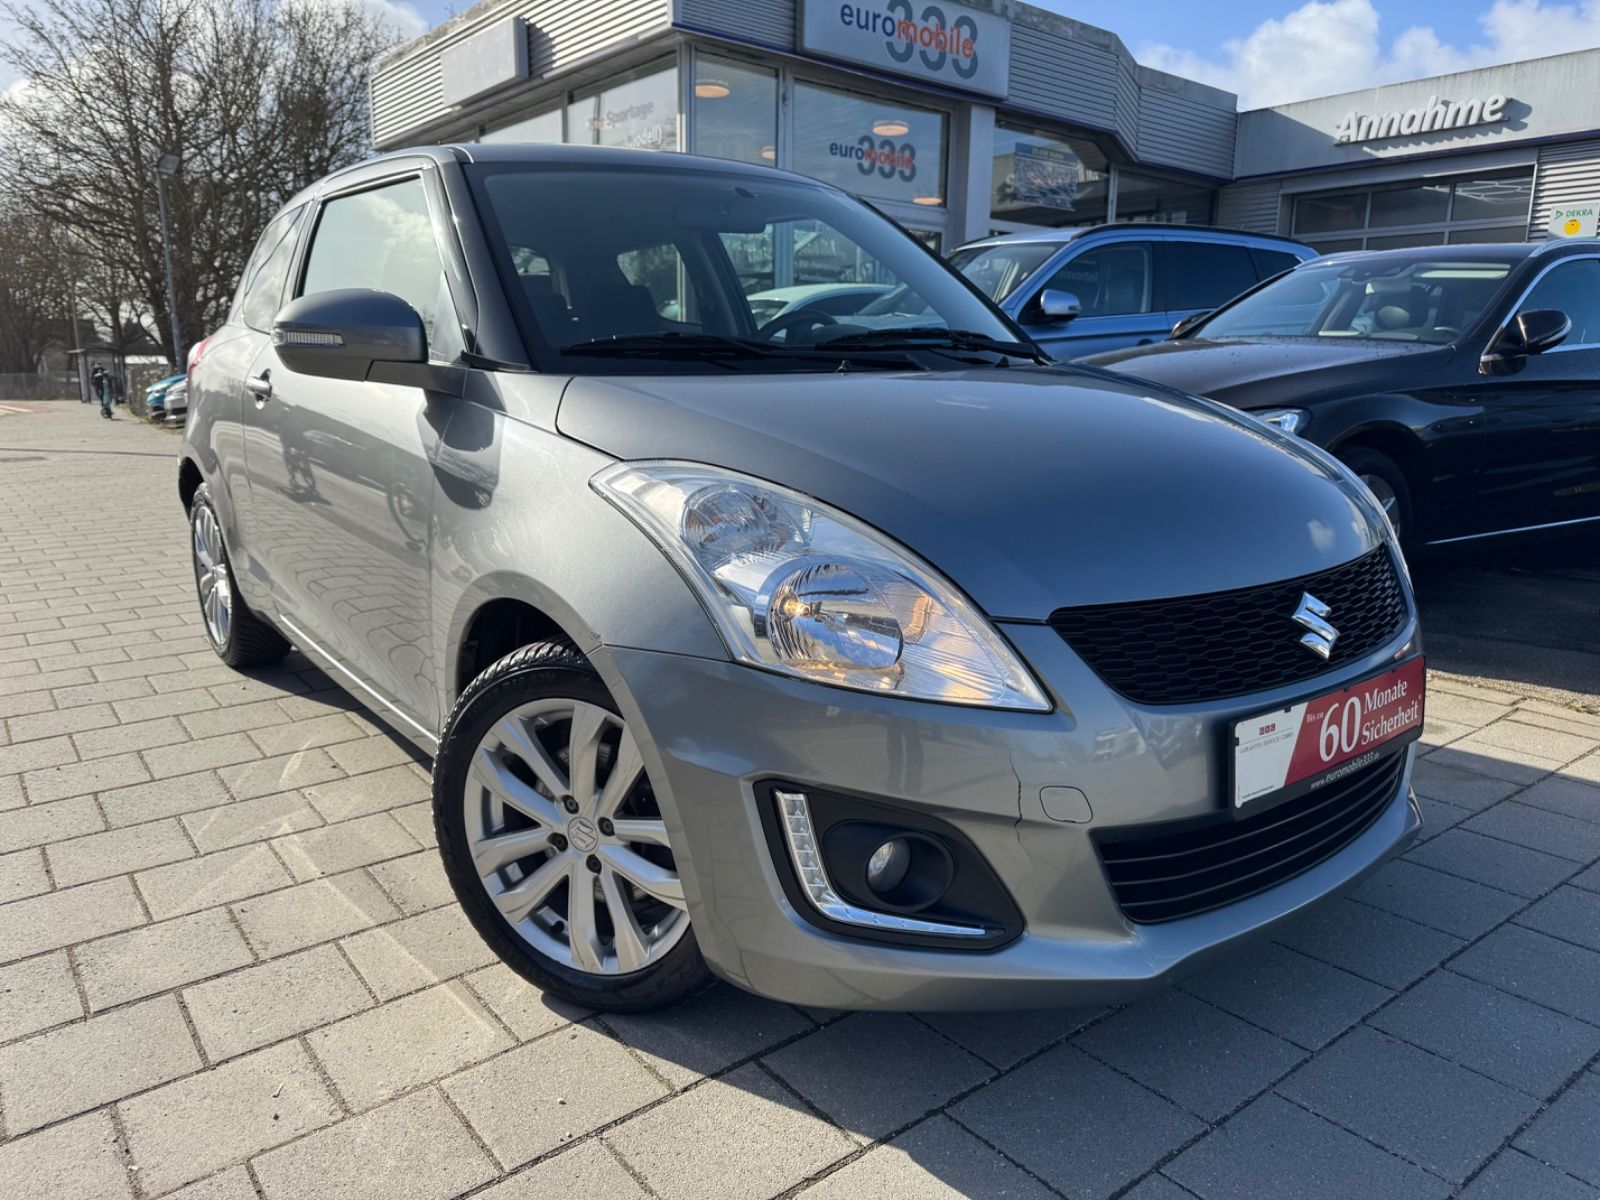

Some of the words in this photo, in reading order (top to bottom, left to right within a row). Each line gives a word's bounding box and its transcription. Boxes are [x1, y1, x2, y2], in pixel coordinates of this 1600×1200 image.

[841, 4, 974, 59] euromobile
[885, 0, 979, 79] 333
[606, 102, 654, 123] Sportage
[1335, 94, 1507, 143] Annahme
[856, 134, 916, 183] 333
[1566, 209, 1593, 217] DEKRA
[1306, 713, 1316, 723] Bis
[1363, 679, 1408, 714] Monate
[1319, 696, 1362, 762] 60
